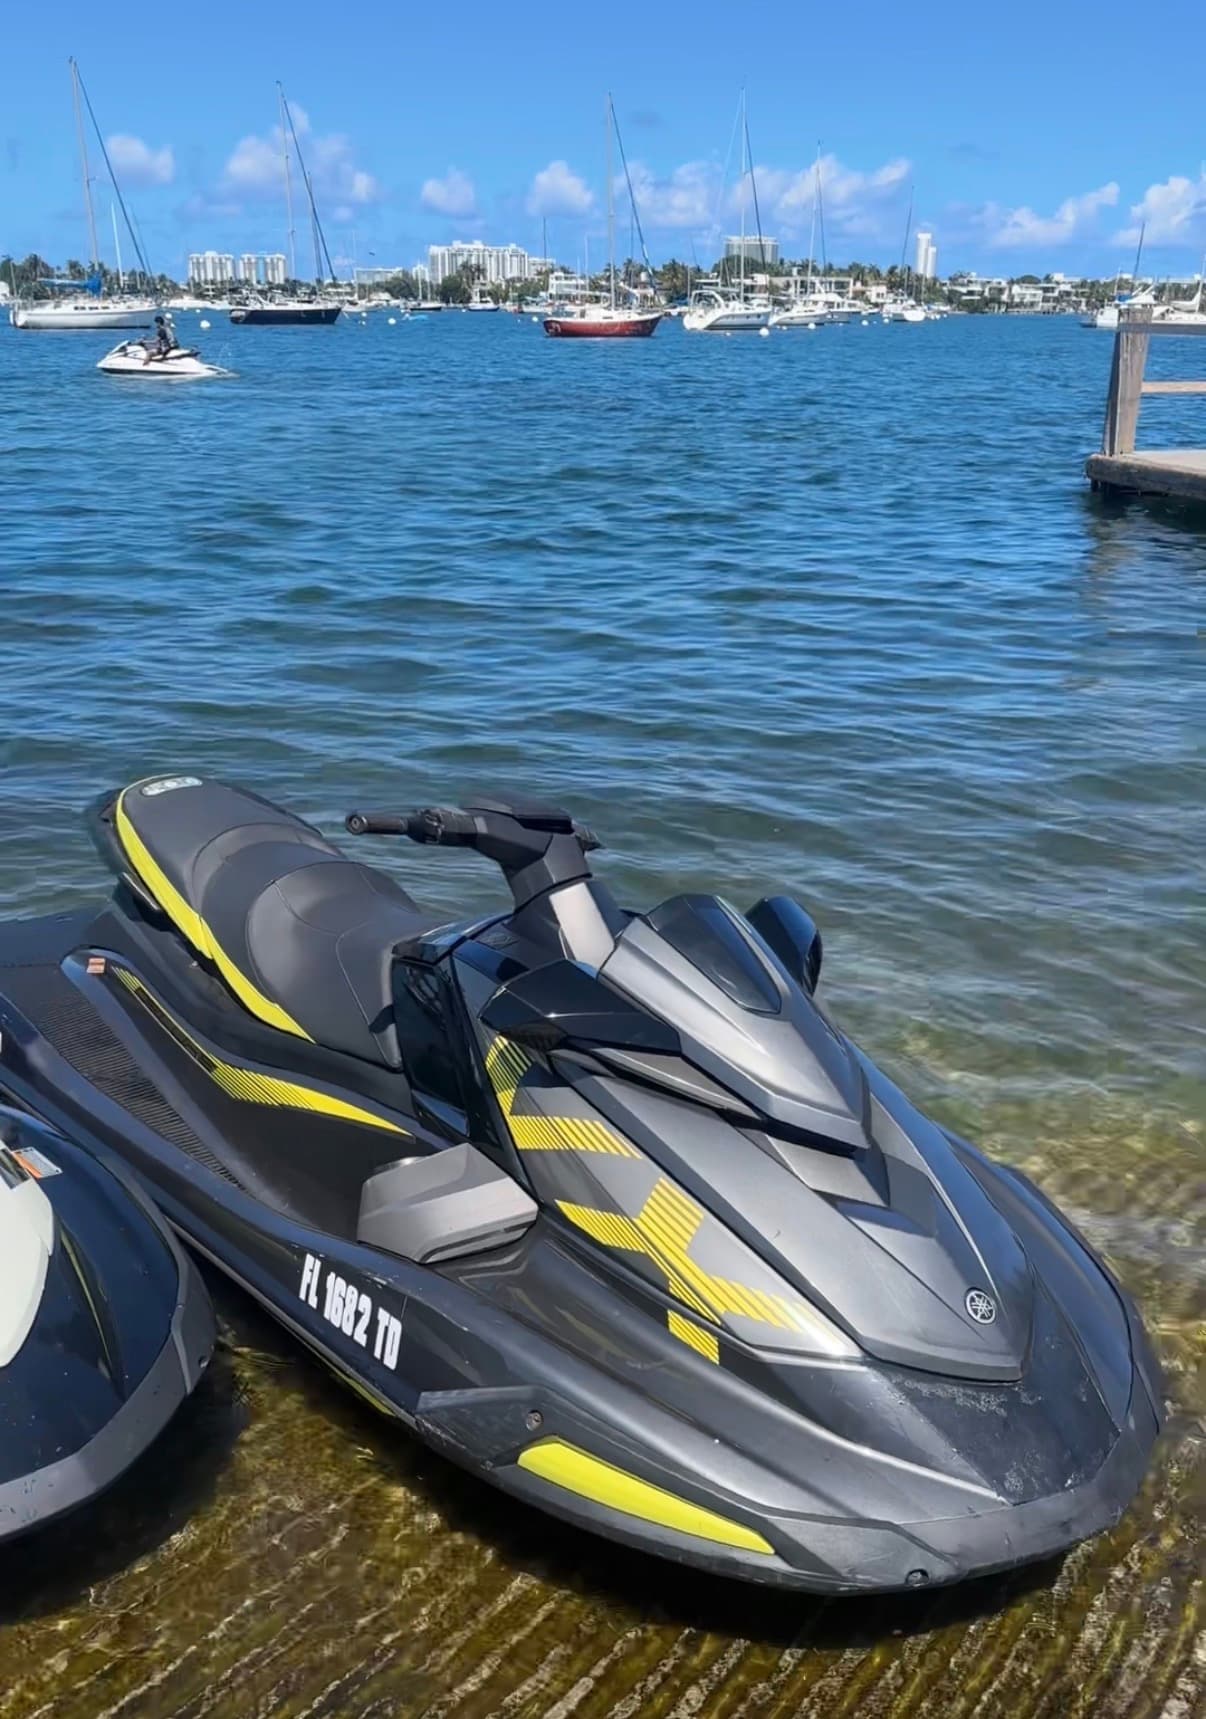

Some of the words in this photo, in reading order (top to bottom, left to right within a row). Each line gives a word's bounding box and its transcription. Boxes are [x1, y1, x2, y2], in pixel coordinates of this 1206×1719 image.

[299, 1253, 322, 1310] FL
[323, 1271, 372, 1348] 1682
[373, 1306, 402, 1371] TD
